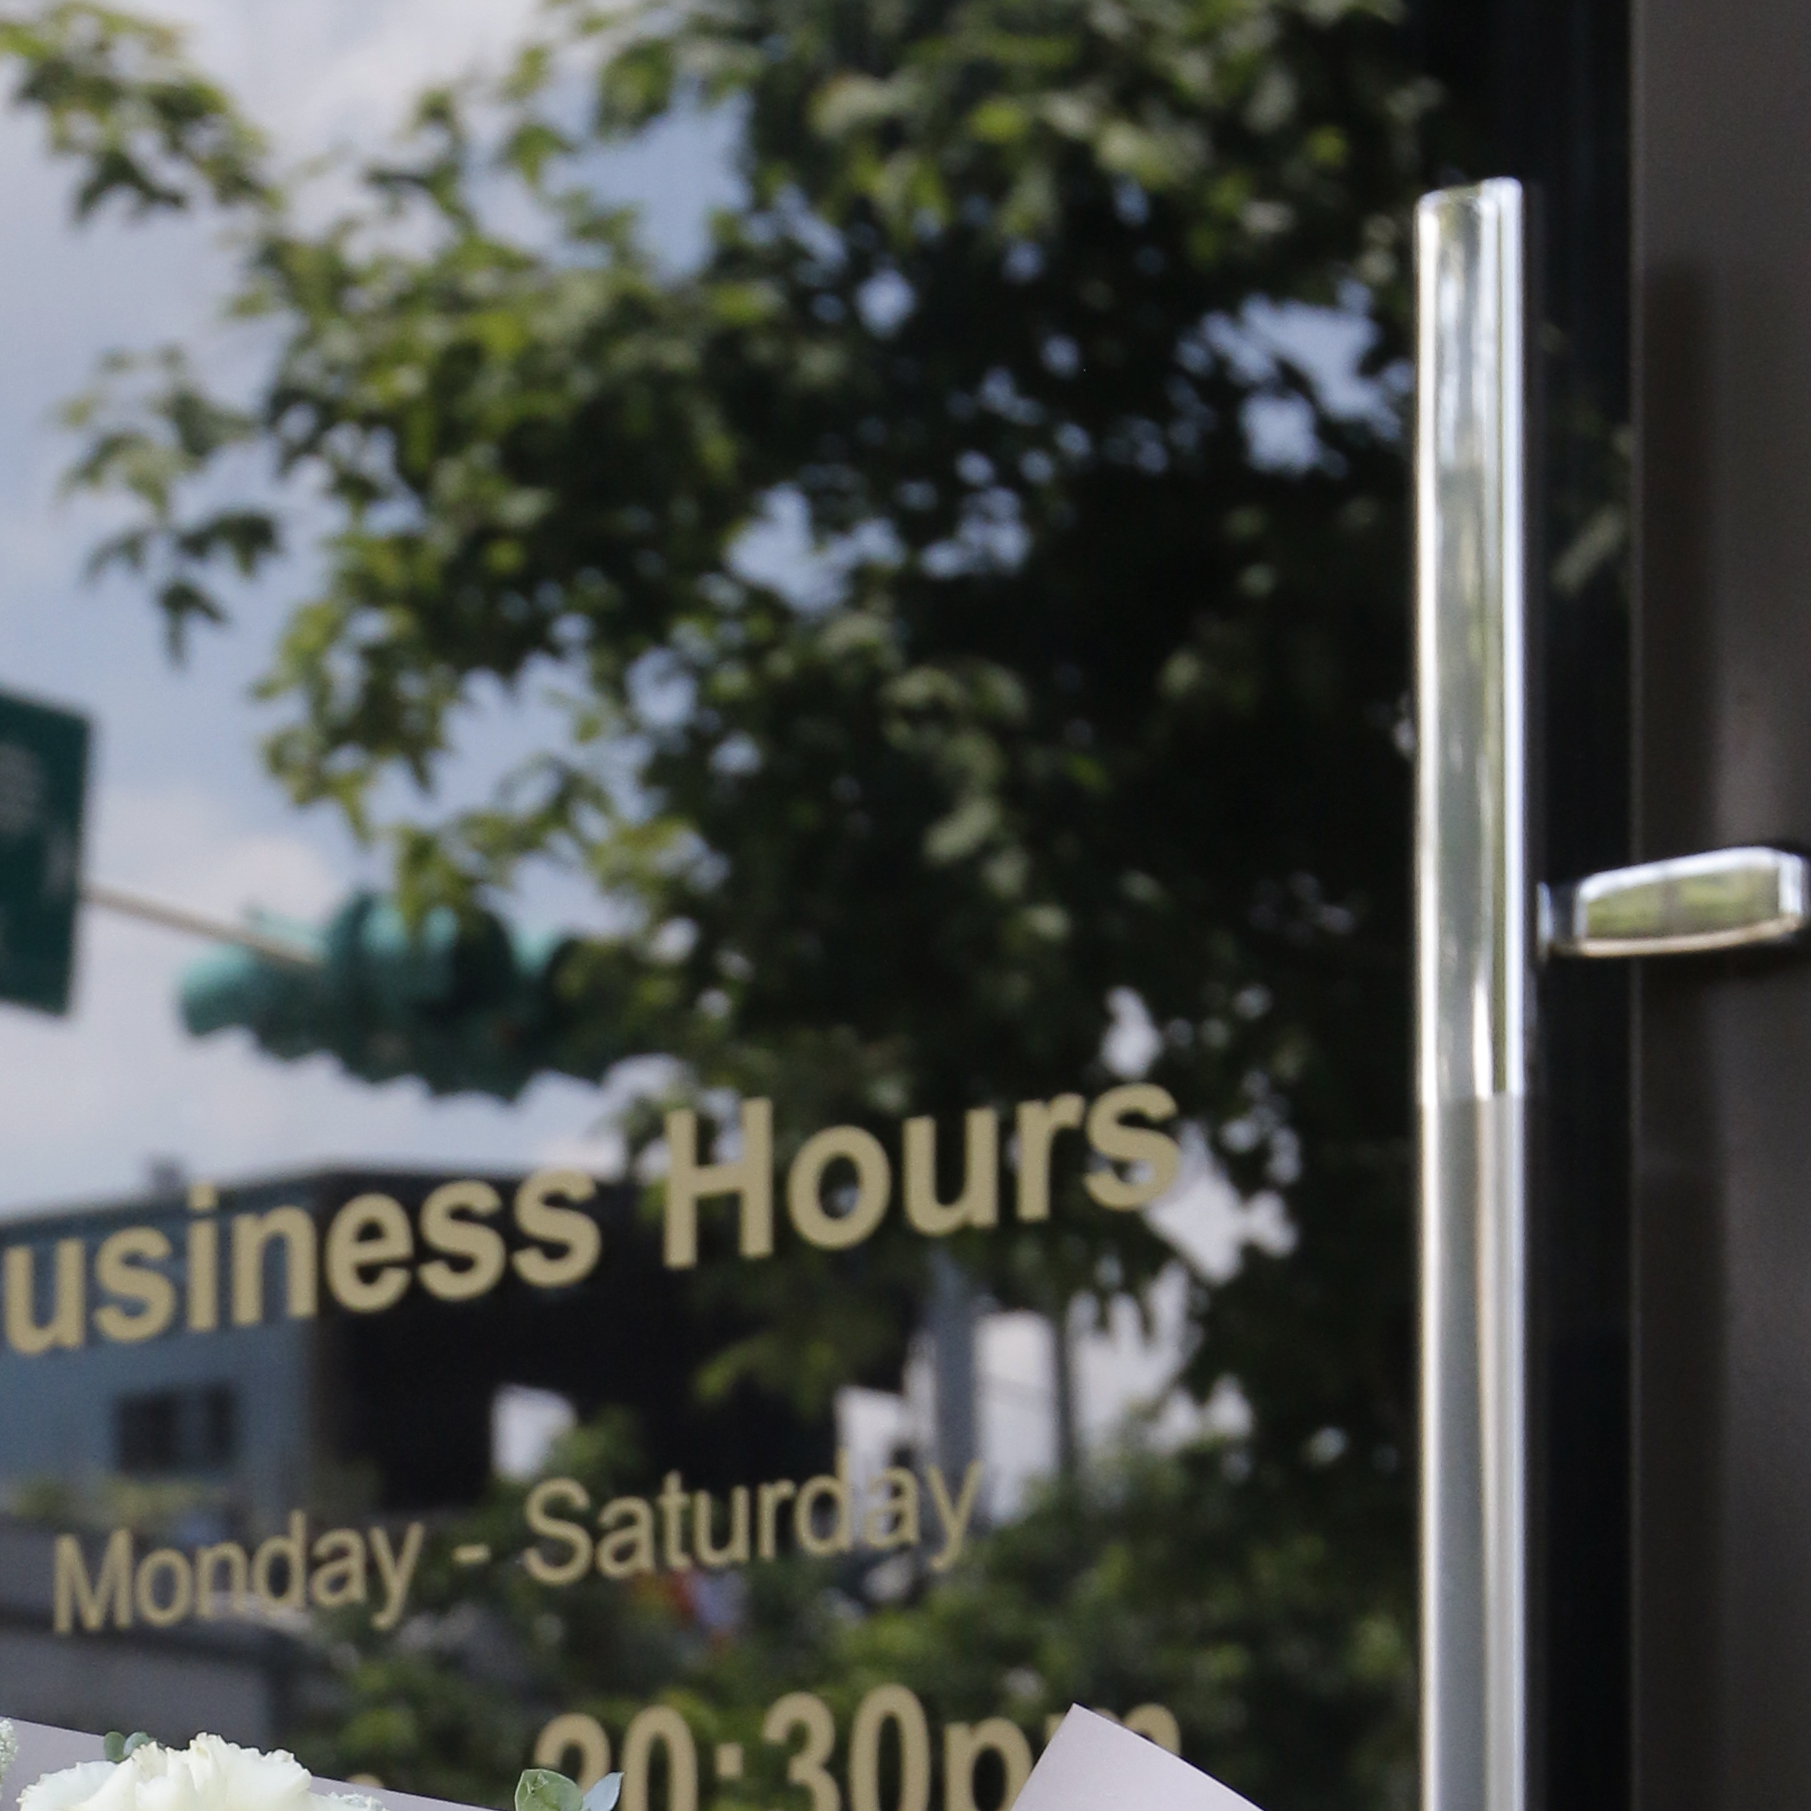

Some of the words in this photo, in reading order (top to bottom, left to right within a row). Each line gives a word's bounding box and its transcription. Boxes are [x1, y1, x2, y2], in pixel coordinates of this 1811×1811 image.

[663, 1082, 1181, 1270] Hours
[53, 1509, 425, 1635] Monday
[452, 1543, 491, 1564] -
[523, 1448, 983, 1588] Saturday
